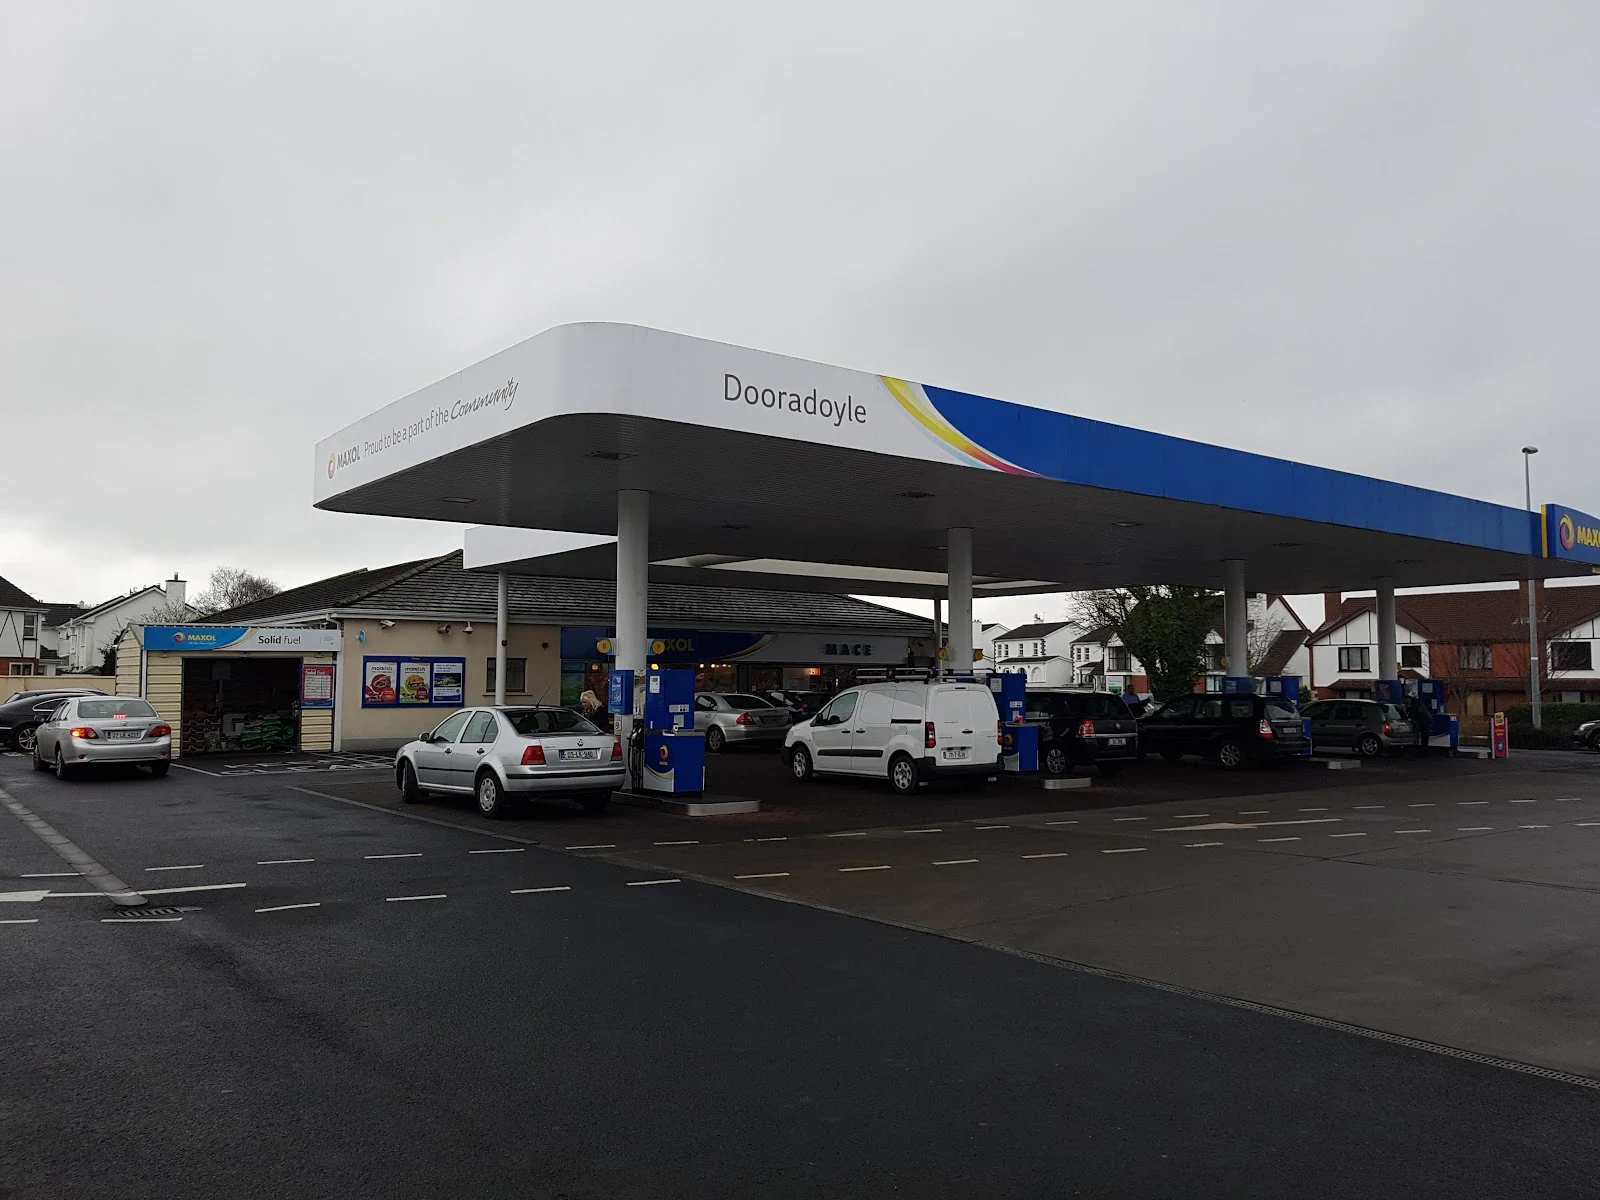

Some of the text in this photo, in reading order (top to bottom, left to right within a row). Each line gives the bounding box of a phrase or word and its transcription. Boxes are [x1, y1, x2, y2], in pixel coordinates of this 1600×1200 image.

[724, 373, 867, 427] Dooradoyle
[337, 376, 519, 470] MAXOL Proud to be a part of the Community
[1577, 526, 1600, 548] MAX
[258, 635, 301, 645] Solid fuel
[666, 638, 695, 652] XOL
[825, 643, 872, 656] MACE
